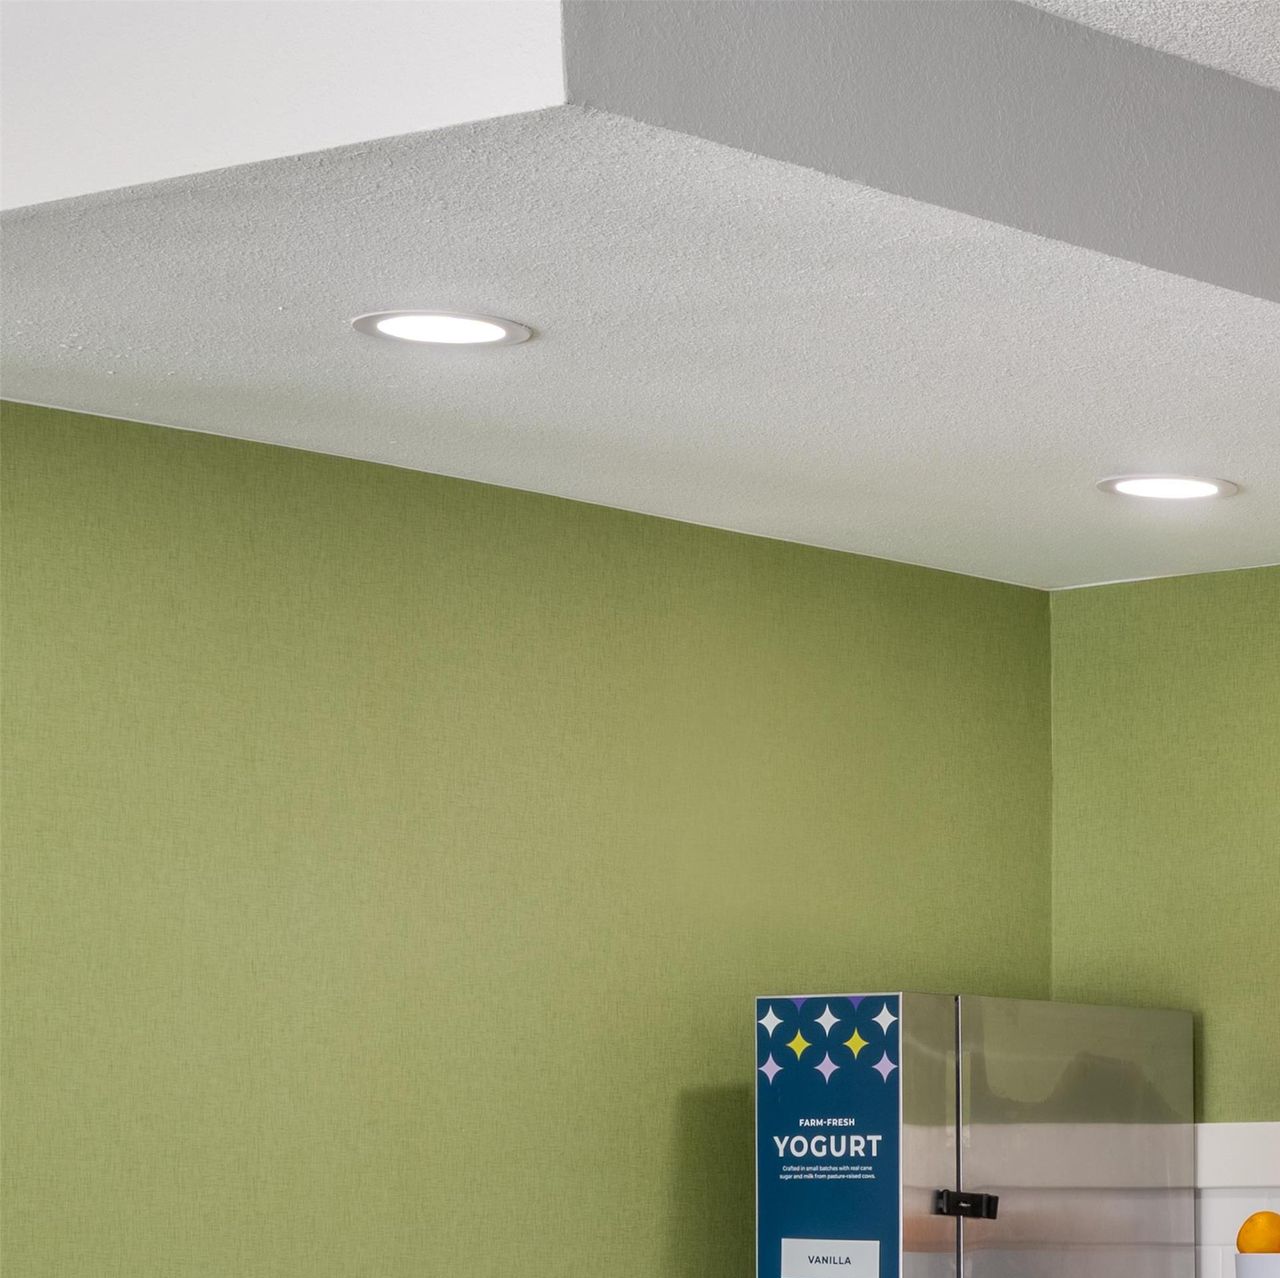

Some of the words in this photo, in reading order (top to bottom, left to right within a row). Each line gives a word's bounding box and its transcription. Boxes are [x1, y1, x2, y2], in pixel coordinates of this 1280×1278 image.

[799, 1118, 856, 1127] FARM-FRESH
[772, 1134, 883, 1158] YOGURT
[807, 1255, 852, 1265] VANILLA
